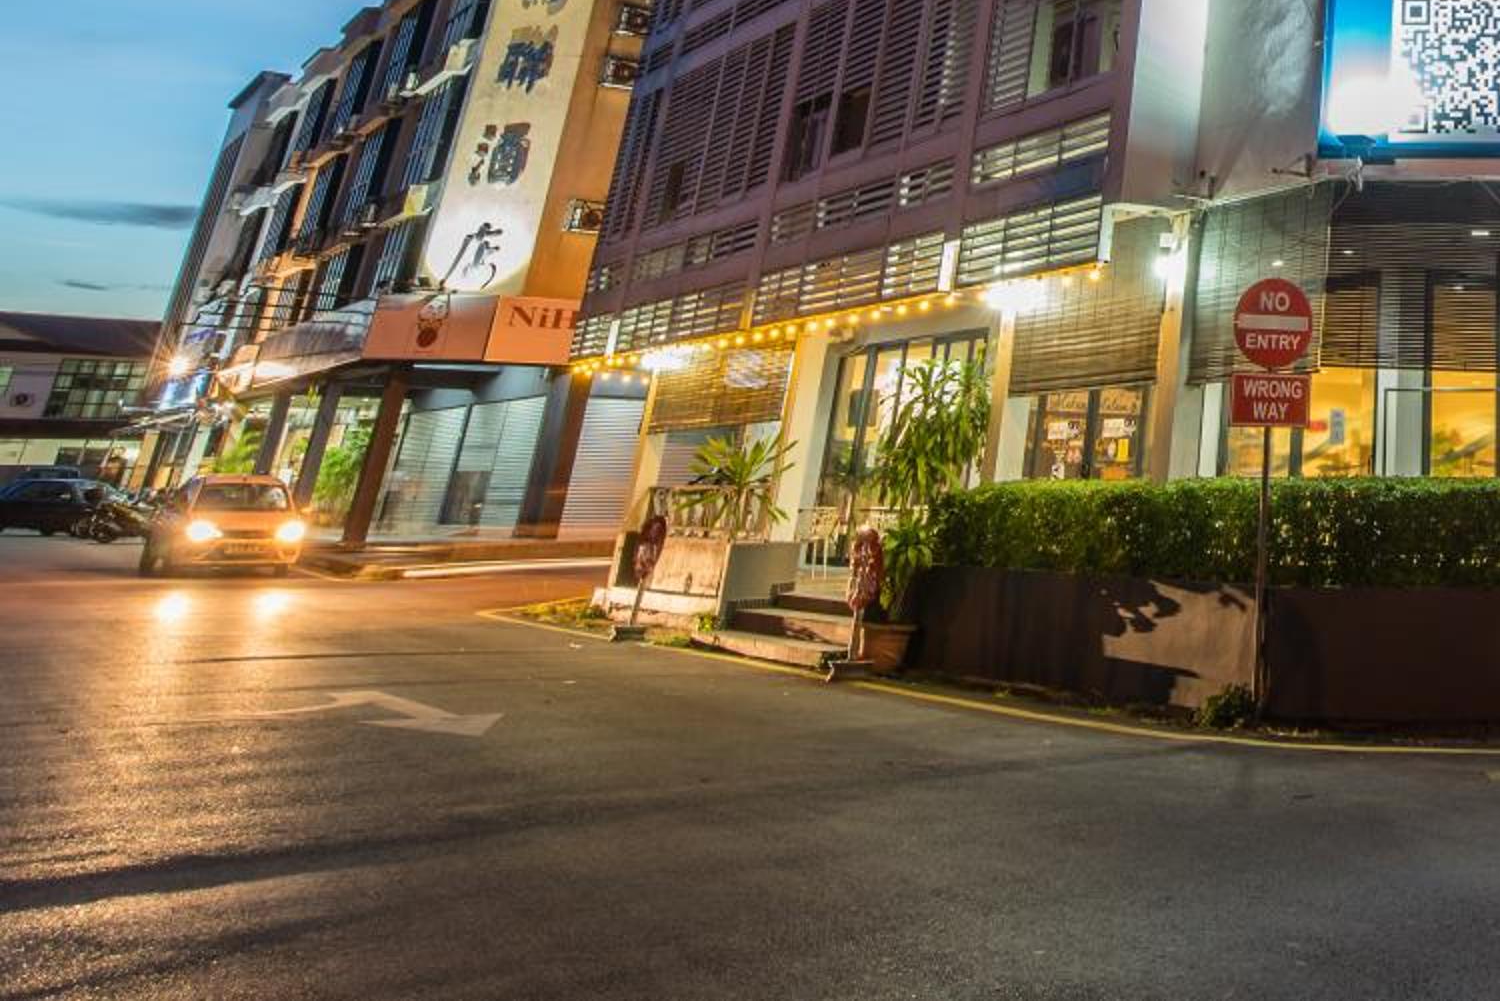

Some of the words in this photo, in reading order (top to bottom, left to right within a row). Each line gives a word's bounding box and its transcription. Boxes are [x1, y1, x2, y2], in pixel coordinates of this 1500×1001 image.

[1260, 291, 1291, 312] NO
[1245, 333, 1301, 350] ENTRY
[1243, 379, 1303, 399] WRONG
[1253, 401, 1289, 420] WAY
